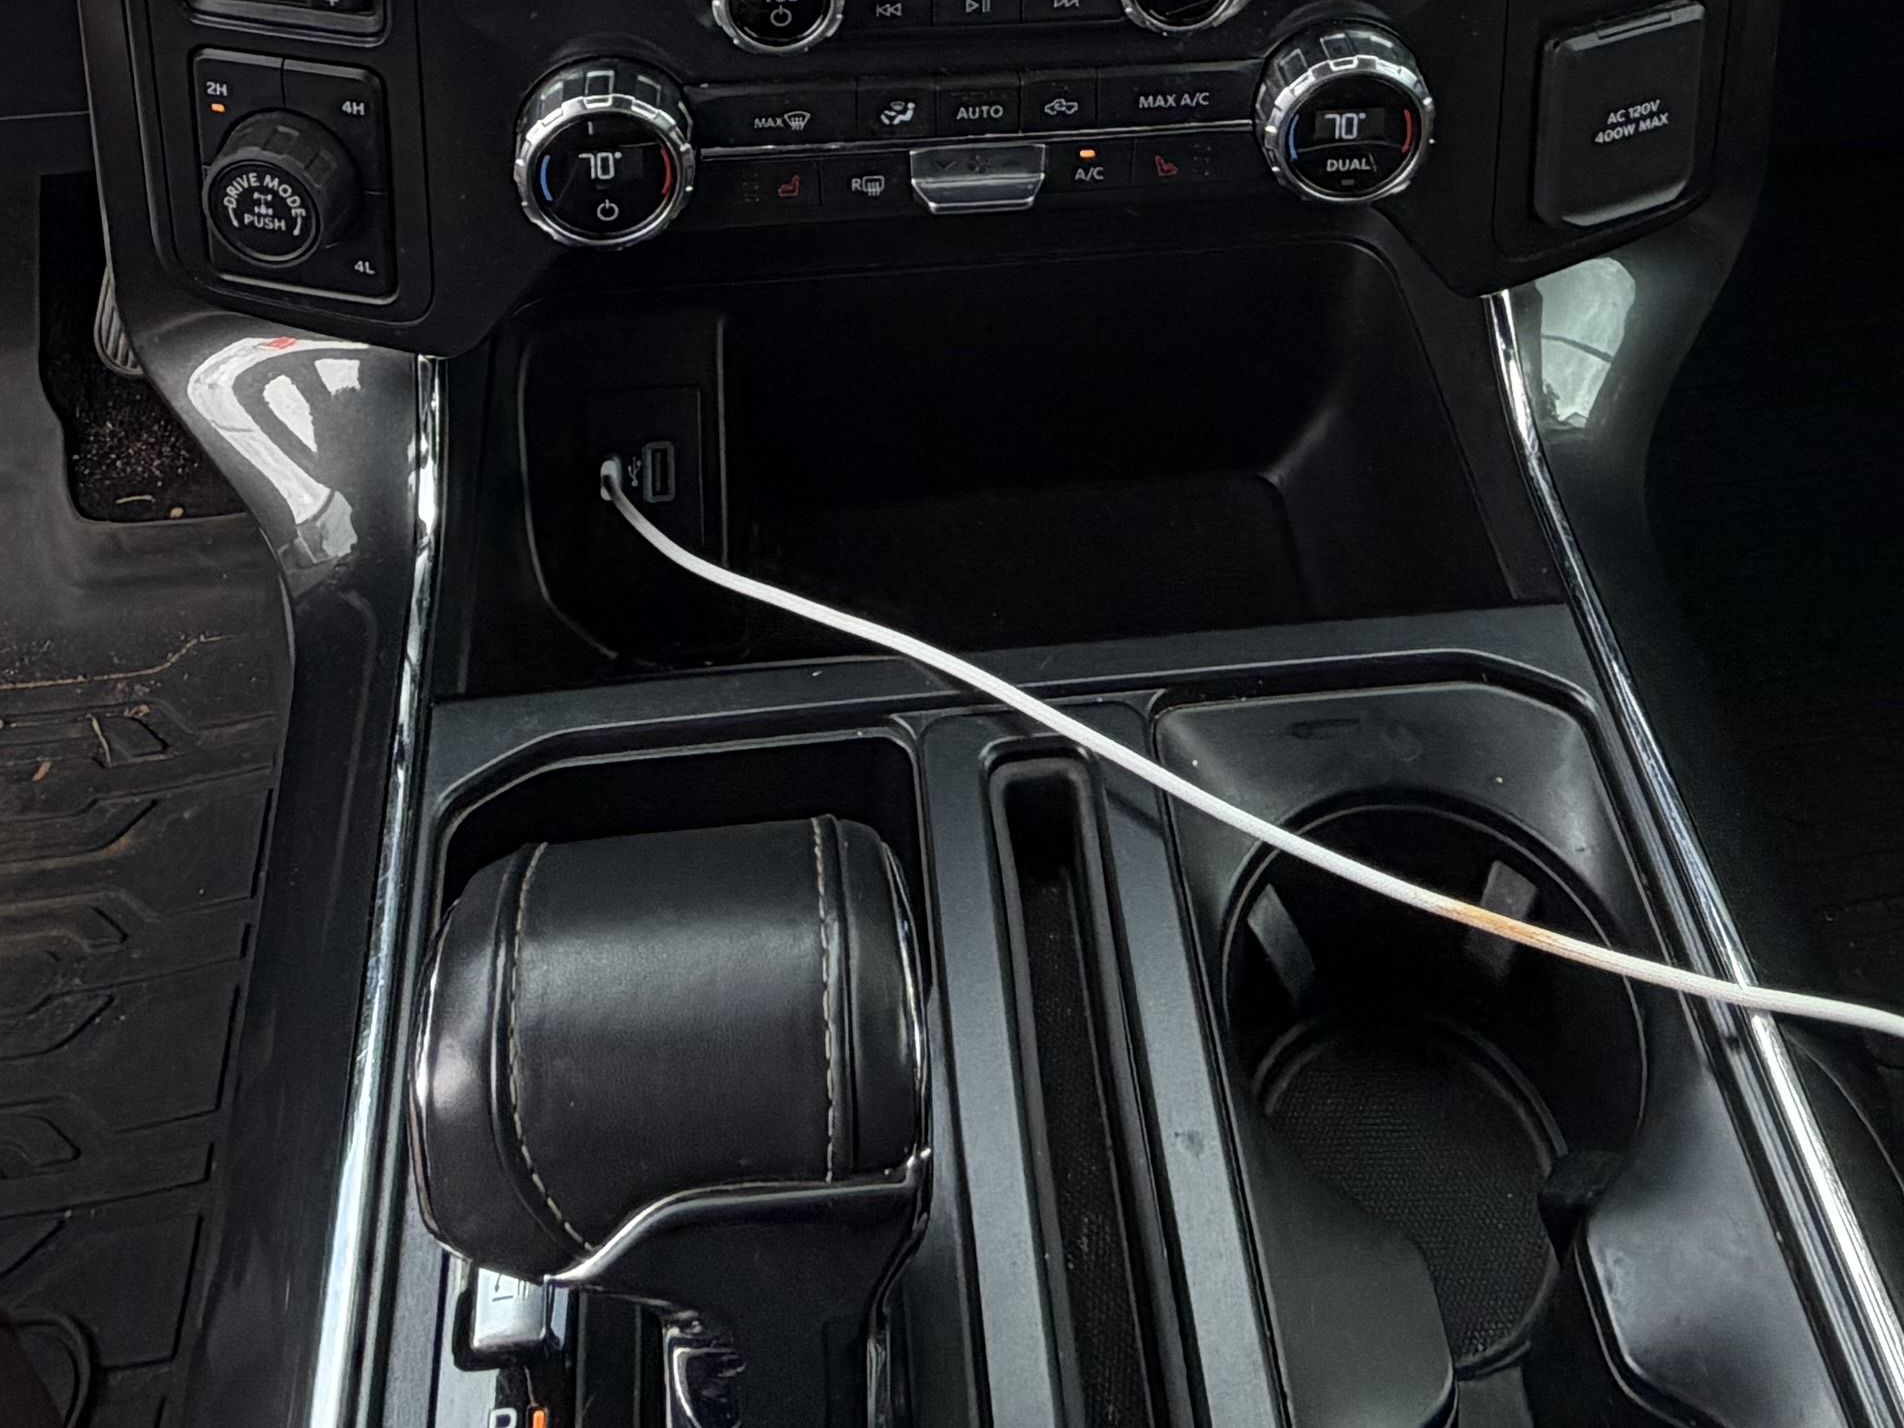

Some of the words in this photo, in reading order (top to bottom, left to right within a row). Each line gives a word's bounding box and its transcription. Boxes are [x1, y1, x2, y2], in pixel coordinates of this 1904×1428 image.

[206, 80, 228, 97] 2H
[341, 100, 366, 117] 4H
[1138, 93, 1177, 109] MAX
[1179, 91, 1210, 108] A/C
[956, 104, 1004, 120] AUTO
[1606, 108, 1627, 125] AC
[1626, 98, 1661, 121] 120V
[754, 116, 784, 130] MAX
[1324, 112, 1367, 141] 70°
[1594, 121, 1638, 145] 400W
[1637, 111, 1670, 133] MAX
[577, 150, 623, 181] 70°
[1074, 164, 1105, 182] A/C
[1325, 156, 1371, 173] DUAL
[223, 172, 261, 209] DRIVE
[263, 174, 307, 219] MODE
[243, 213, 287, 232] PUSH
[353, 259, 377, 276] 4L
